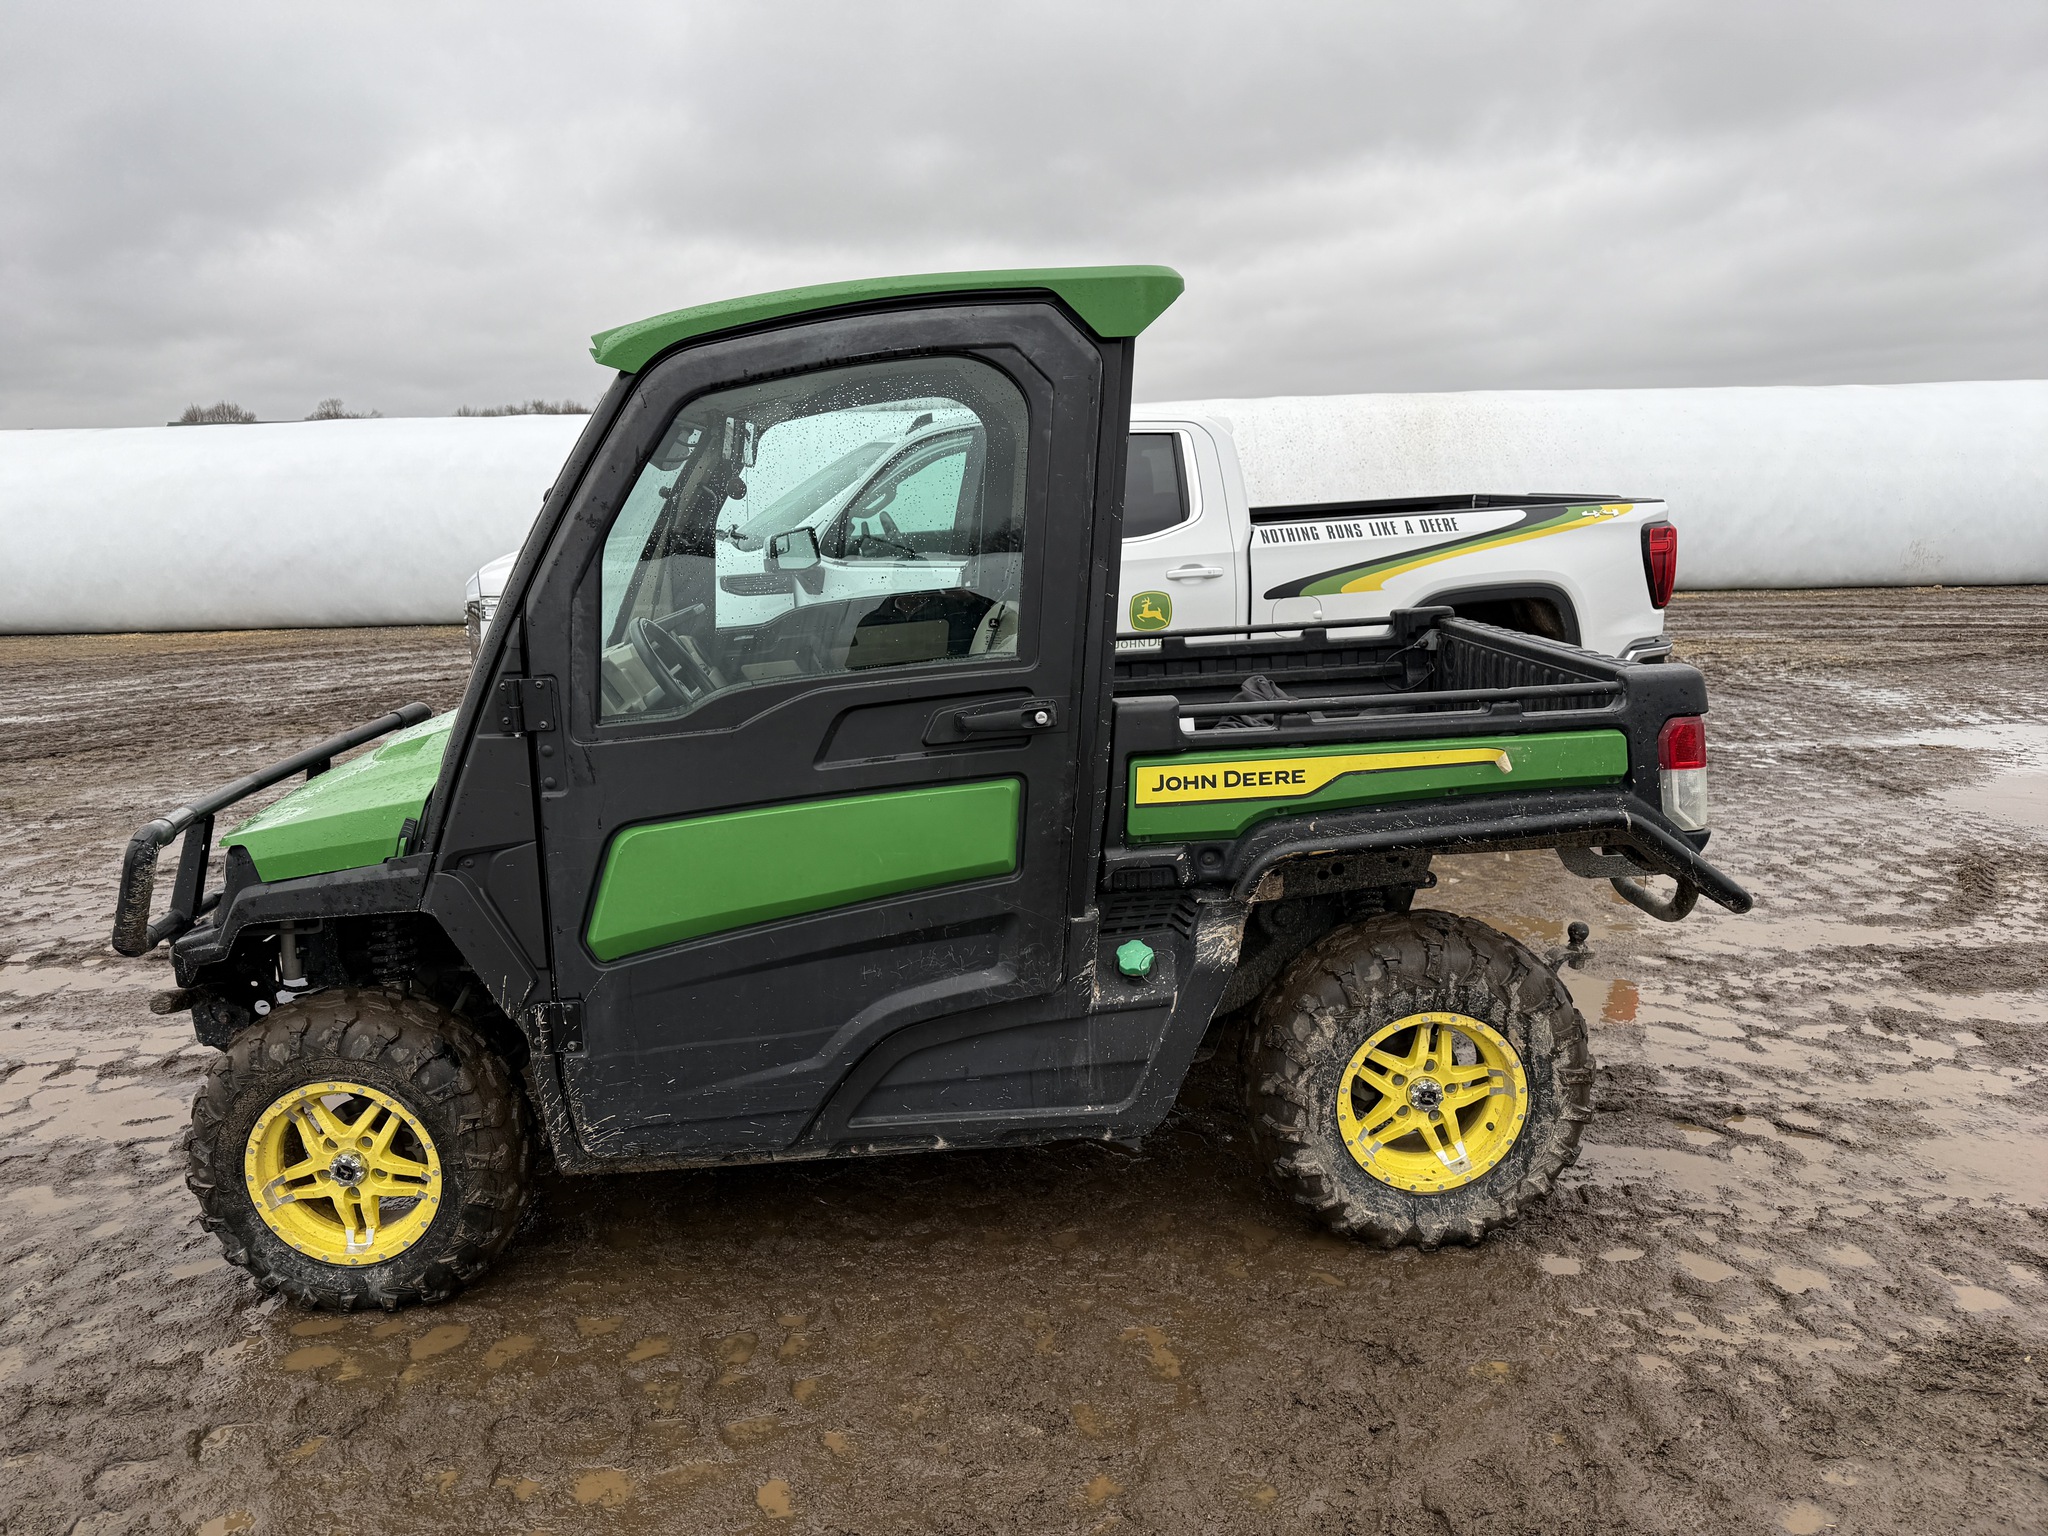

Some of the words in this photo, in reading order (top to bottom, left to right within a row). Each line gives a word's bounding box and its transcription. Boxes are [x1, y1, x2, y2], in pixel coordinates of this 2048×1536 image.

[1260, 525, 1320, 544] NOTHING
[1326, 523, 1363, 540] RUNS
[1369, 521, 1398, 537] LIKE
[1405, 520, 1414, 534] A
[1419, 517, 1459, 533] DEERE
[1116, 639, 1145, 649] JOHN
[1151, 774, 1217, 792] JOHN
[1223, 769, 1306, 788] DEERE
